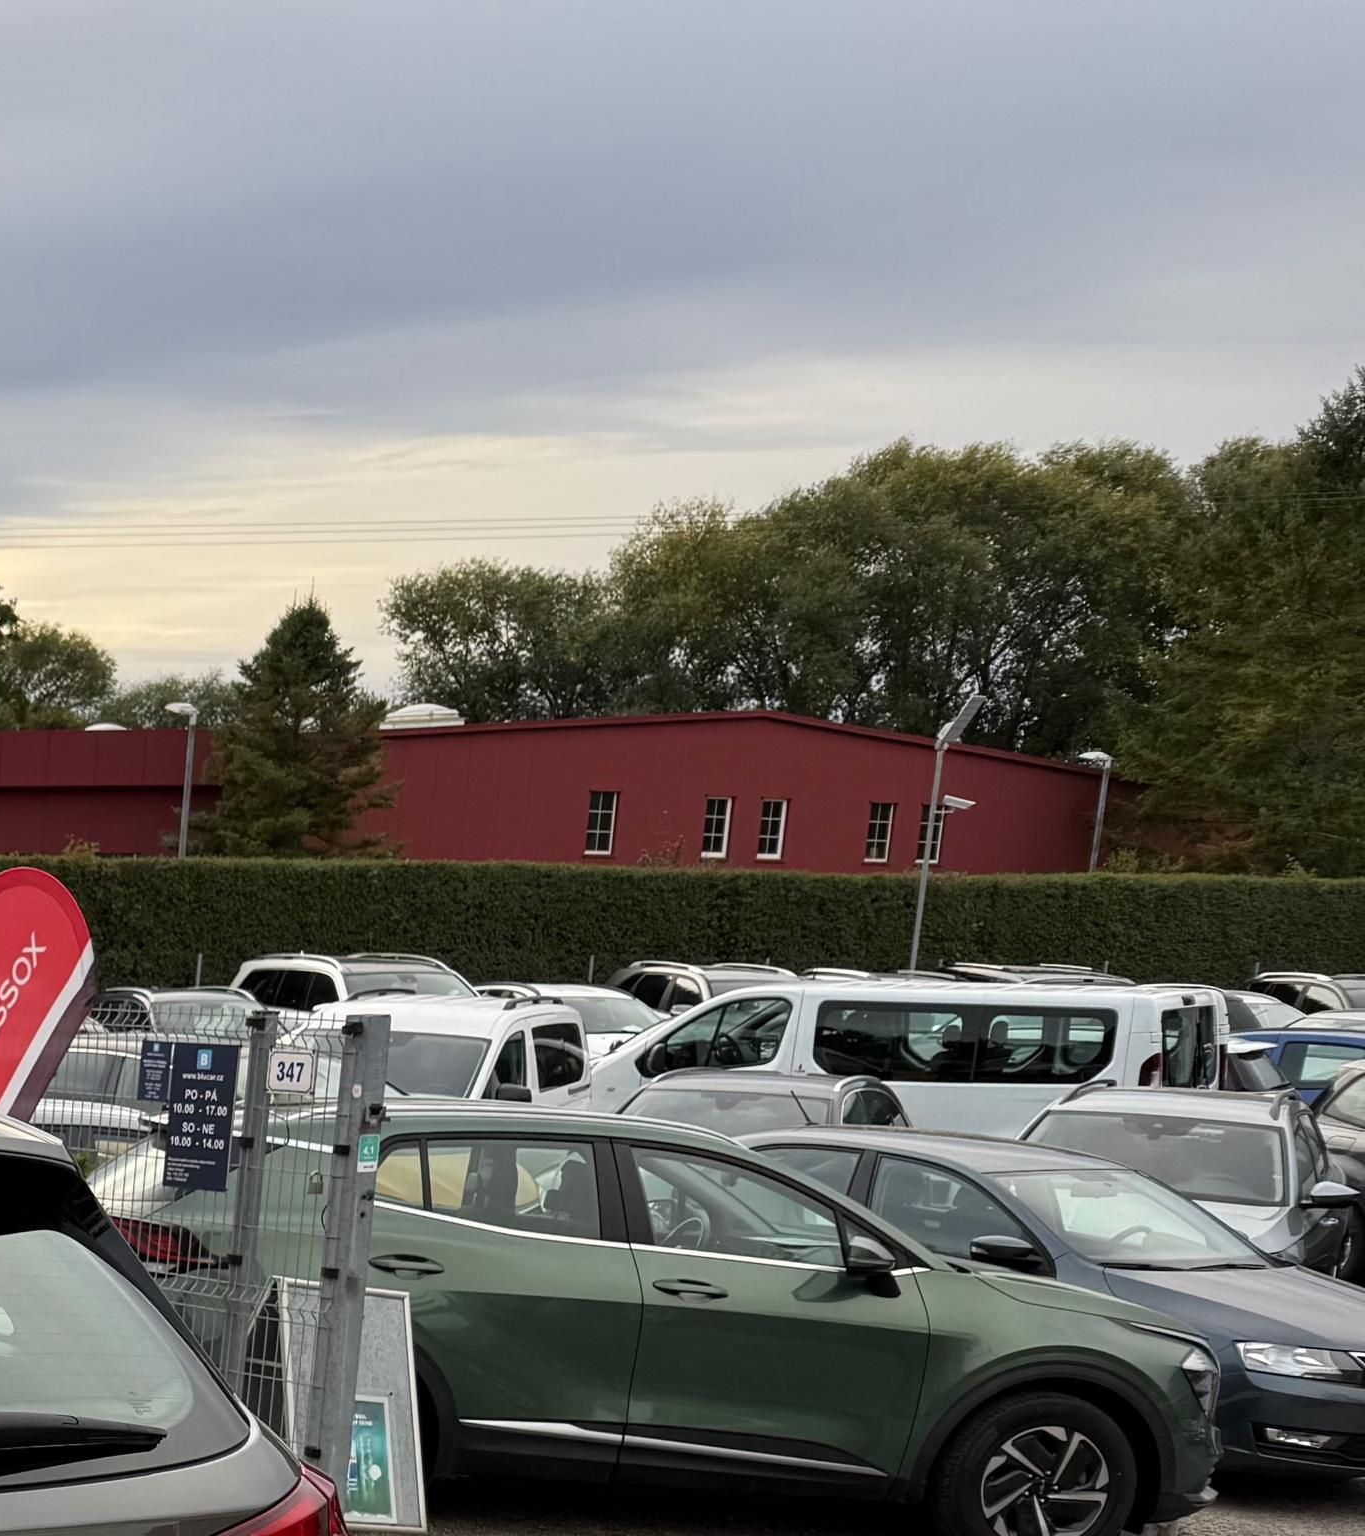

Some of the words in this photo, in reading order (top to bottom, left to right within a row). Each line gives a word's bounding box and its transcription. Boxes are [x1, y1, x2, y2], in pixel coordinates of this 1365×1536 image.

[182, 1072, 224, 1082] www.blucar.cz
[276, 1061, 305, 1083] 347
[184, 1088, 198, 1101] PO
[205, 1088, 218, 1102] PÁ
[173, 1103, 195, 1114] 10.00
[206, 1105, 228, 1117] 17.00
[182, 1121, 195, 1133] SO
[202, 1123, 215, 1135] NE
[170, 1135, 192, 1147] 10.00
[203, 1138, 225, 1150] 14.00
